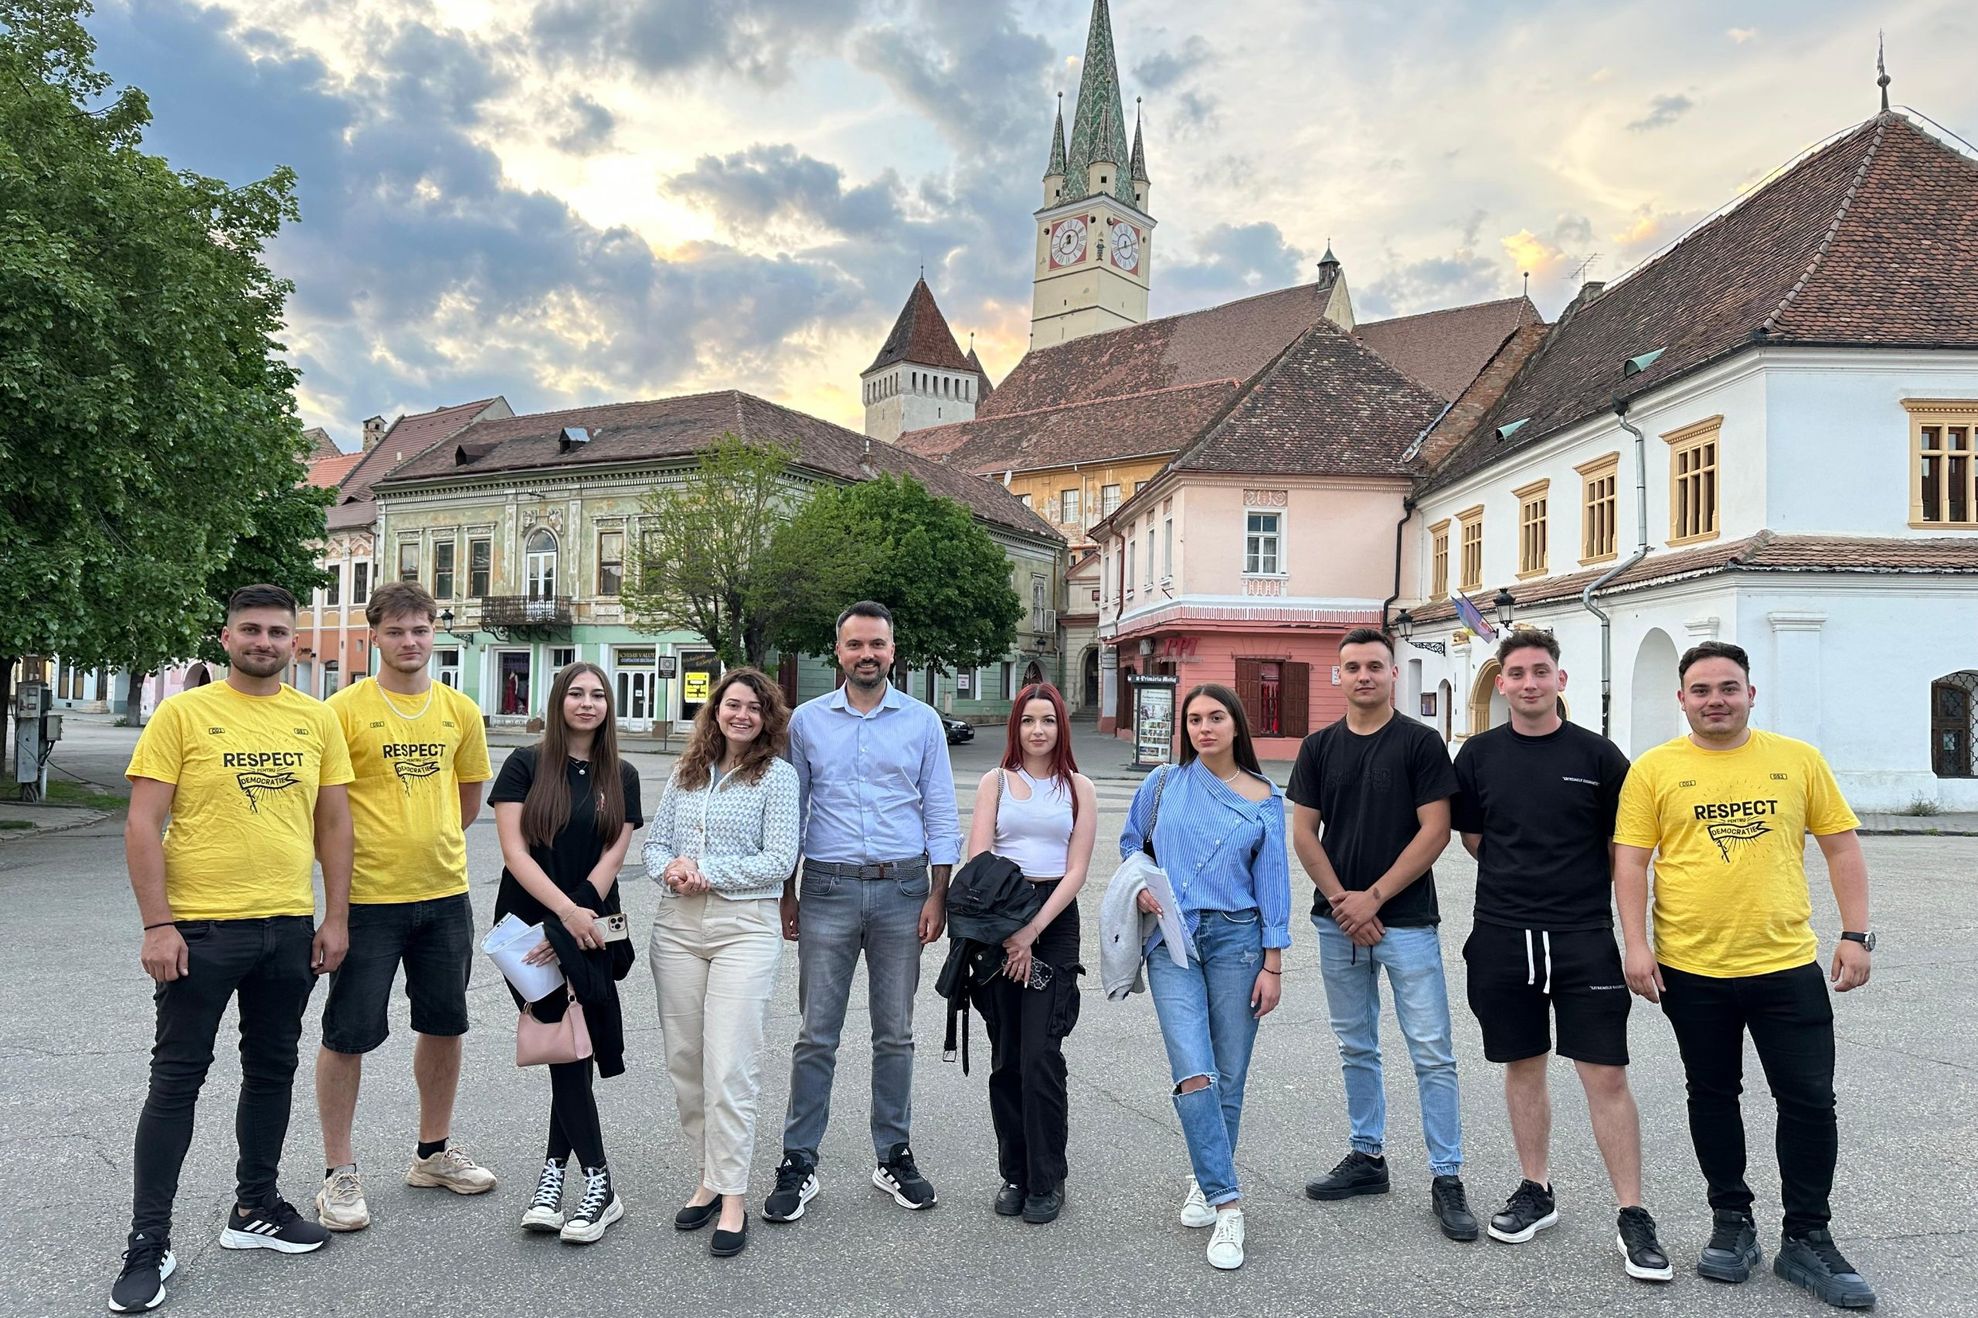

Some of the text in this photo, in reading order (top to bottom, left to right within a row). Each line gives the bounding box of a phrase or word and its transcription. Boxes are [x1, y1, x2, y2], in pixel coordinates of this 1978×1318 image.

[383, 743, 447, 759] RESPECT
[223, 752, 304, 768] RESPECT
[1693, 800, 1778, 820] RESPECT
